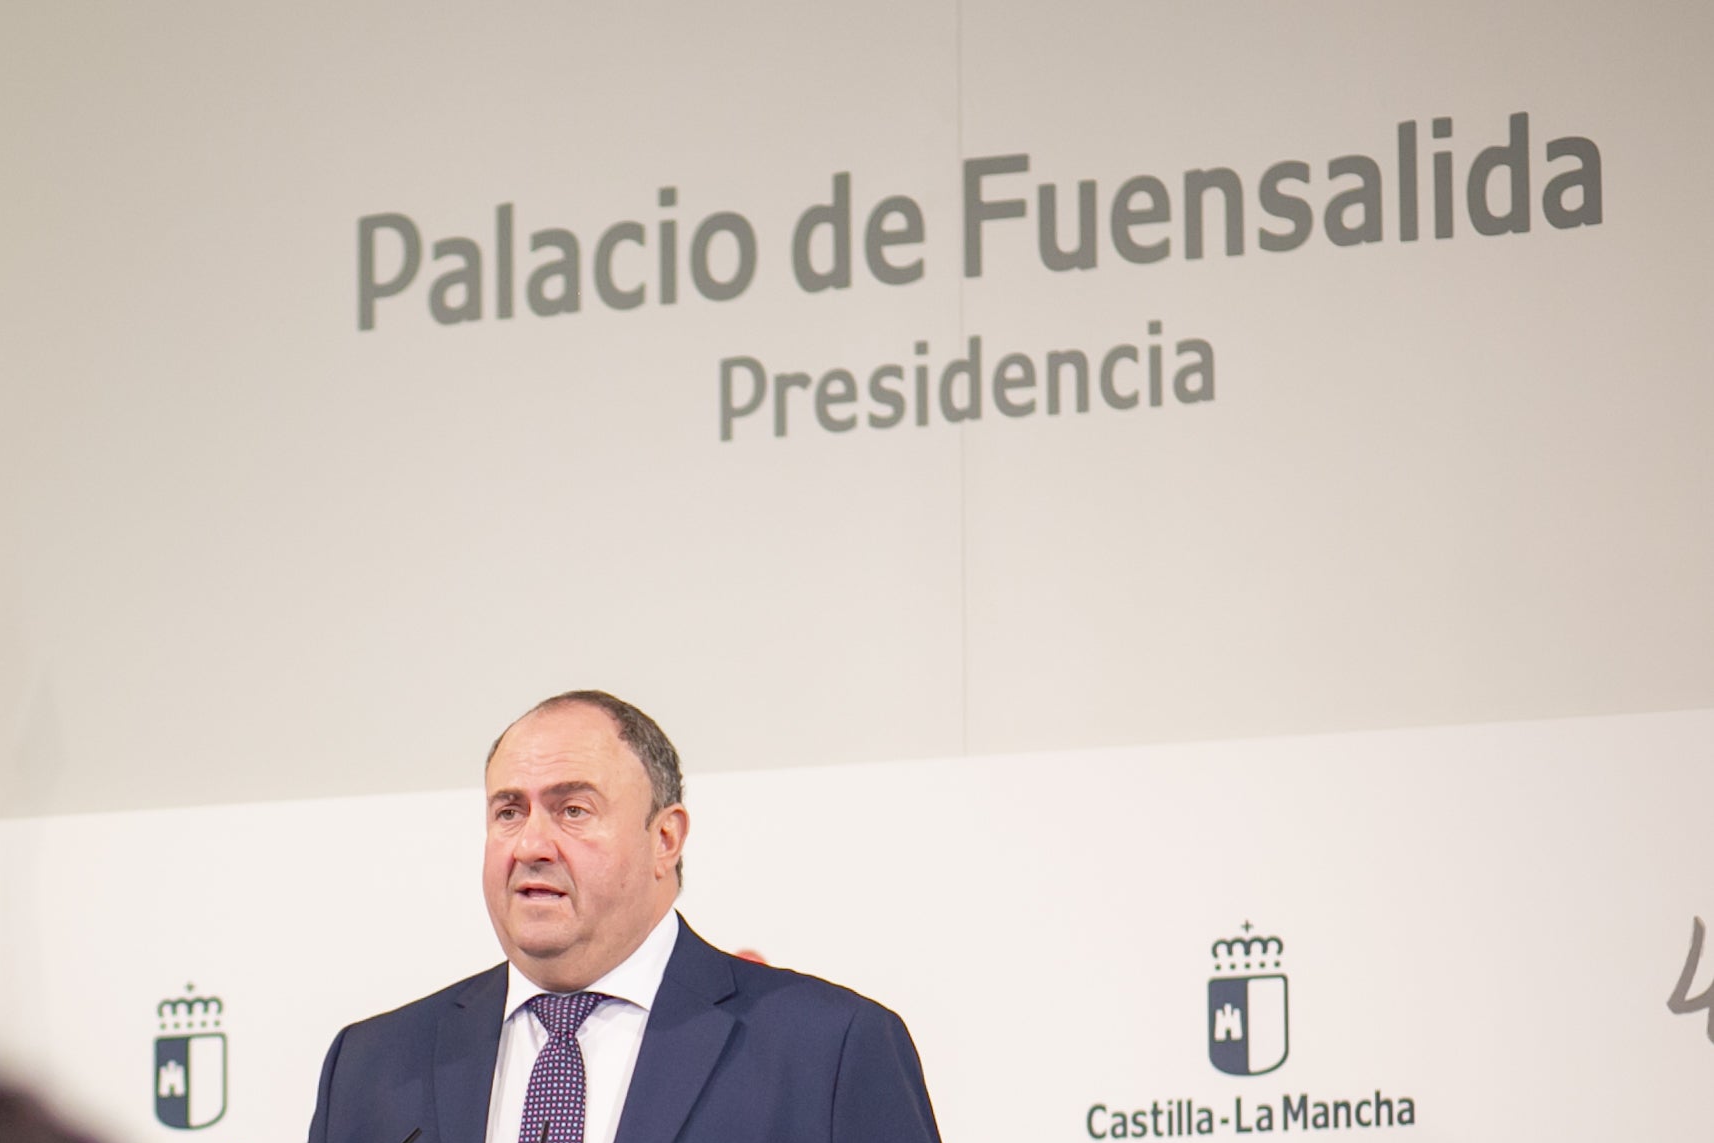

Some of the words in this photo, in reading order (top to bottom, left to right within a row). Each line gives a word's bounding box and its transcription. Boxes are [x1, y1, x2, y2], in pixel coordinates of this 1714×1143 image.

[355, 186, 759, 332] Palacio
[791, 171, 927, 293] de
[961, 111, 1606, 279] Fuensalida
[718, 321, 1218, 442] Presidencia
[1086, 1097, 1274, 1139] Castilla-La
[1282, 1089, 1416, 1131] Mancha
